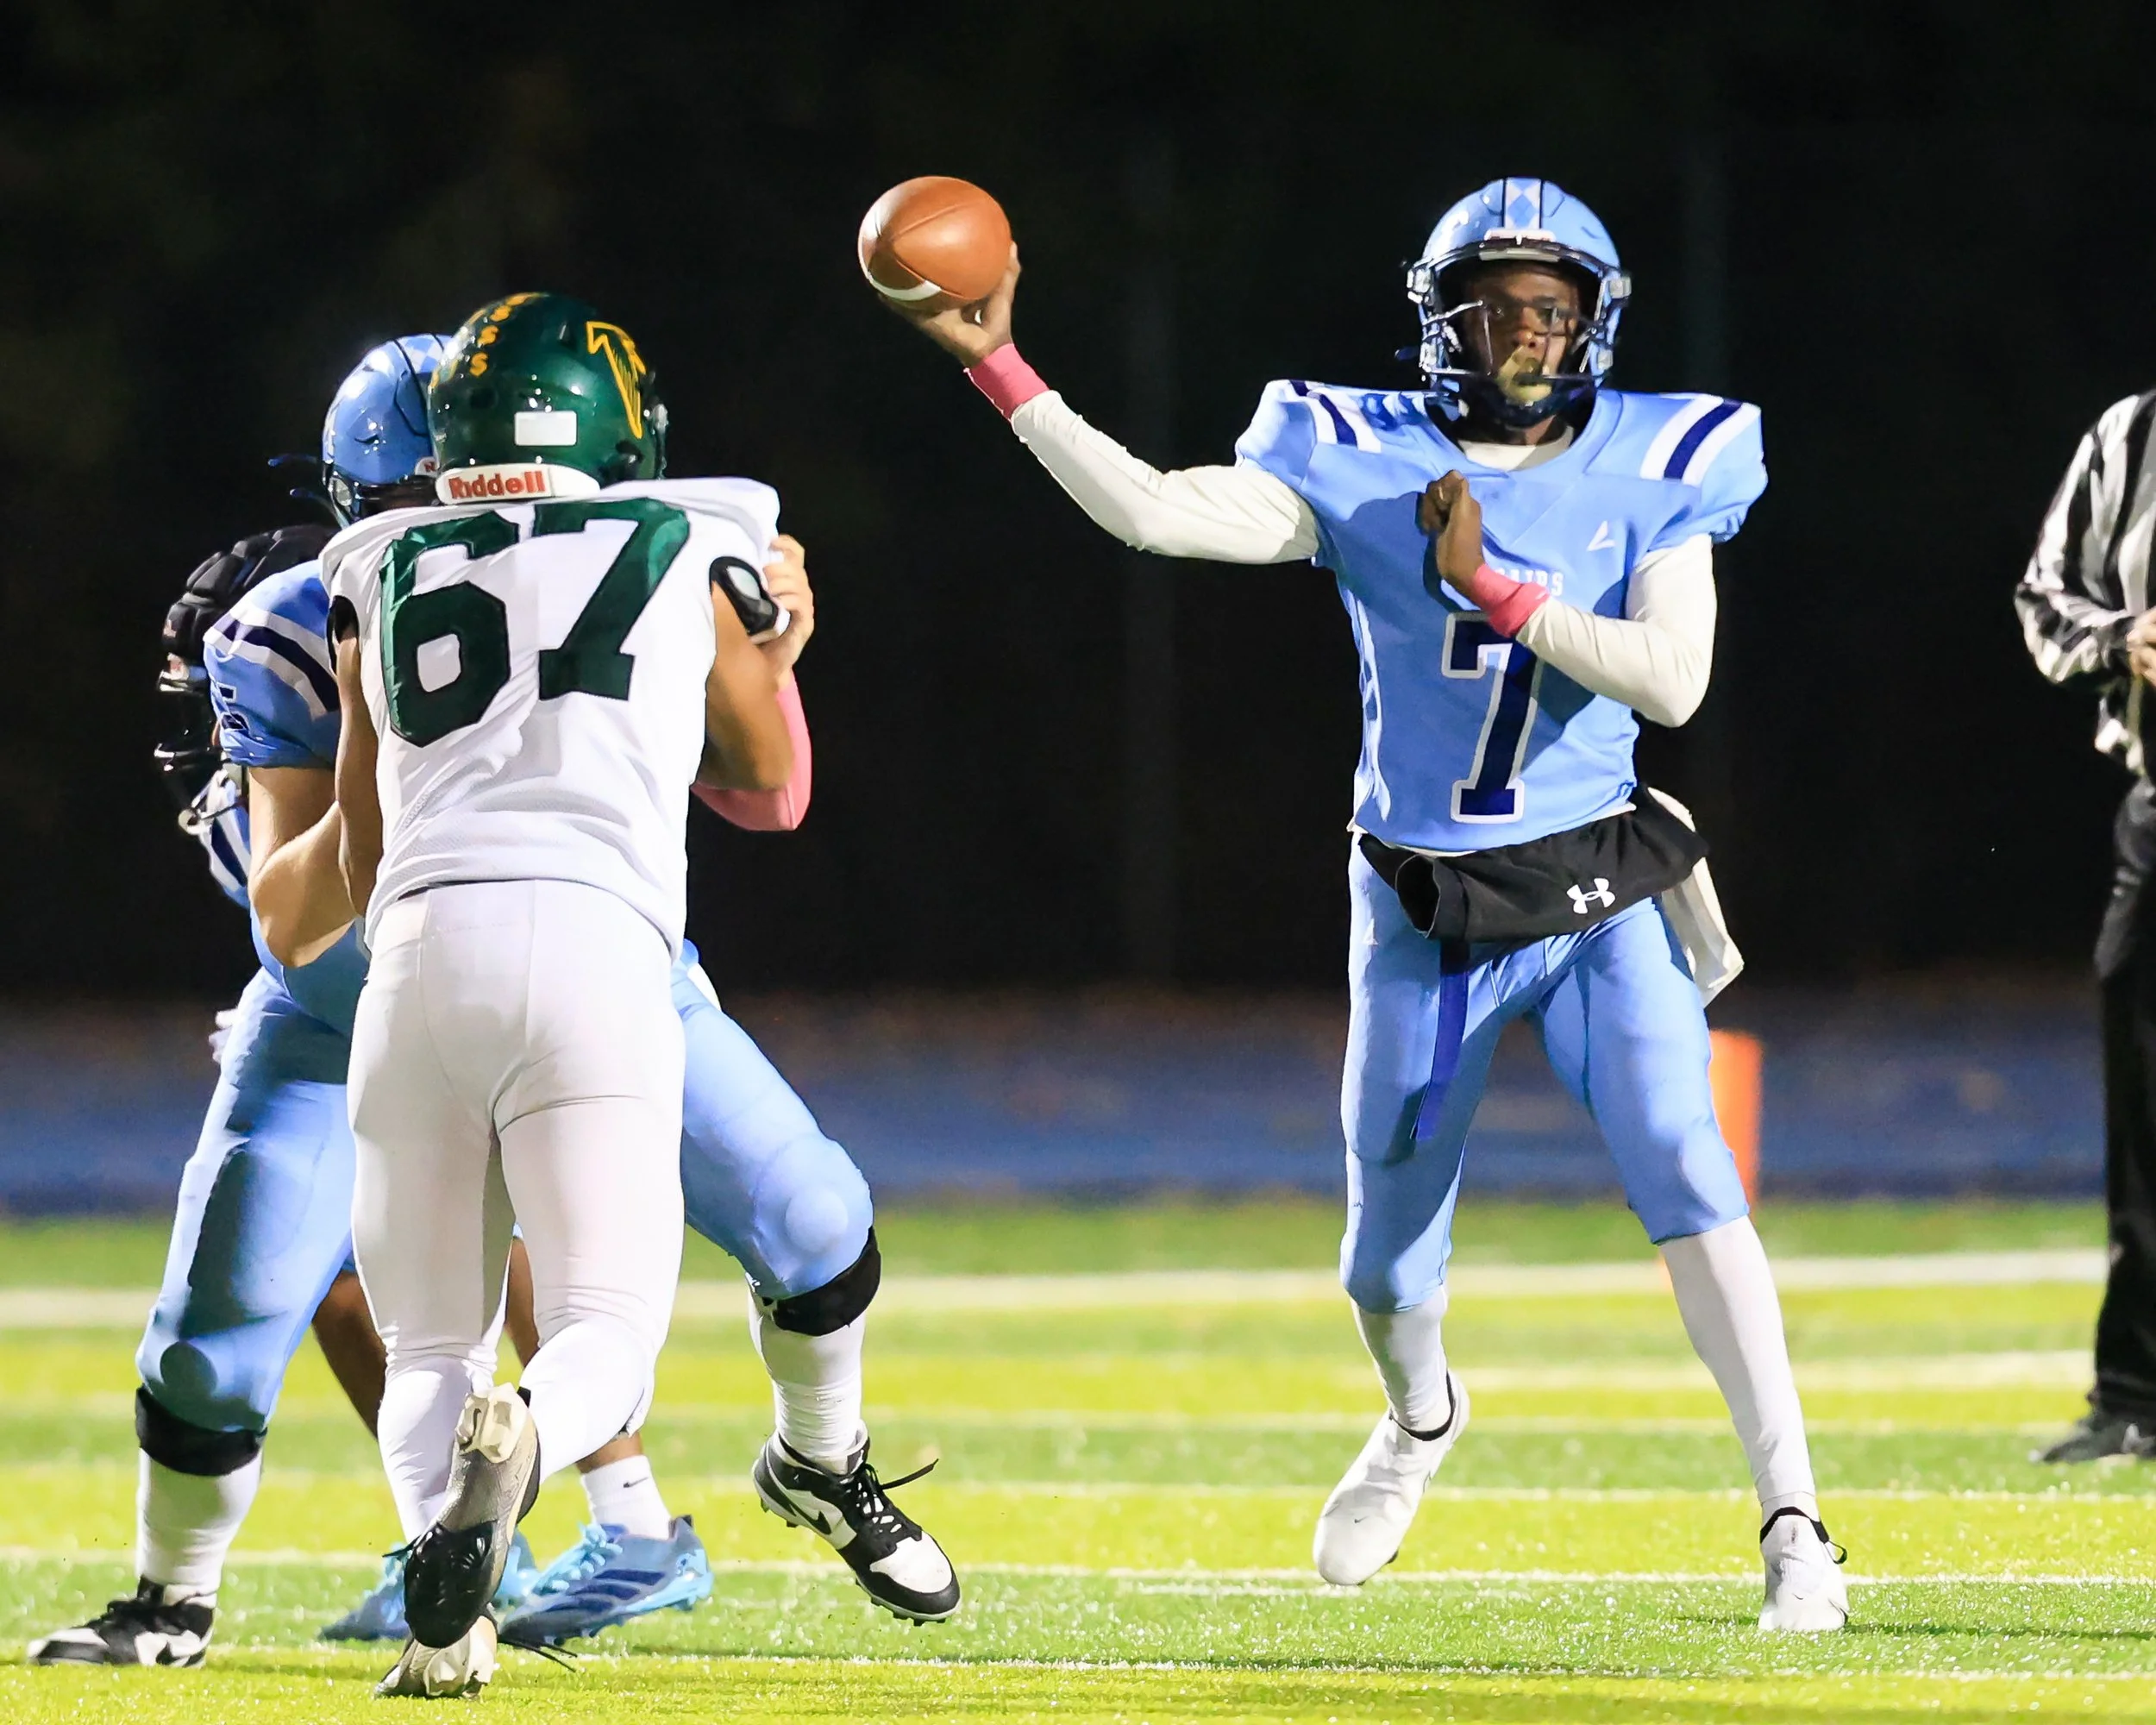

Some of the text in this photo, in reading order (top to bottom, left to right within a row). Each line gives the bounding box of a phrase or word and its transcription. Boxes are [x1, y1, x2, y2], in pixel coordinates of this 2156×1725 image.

[448, 471, 546, 499] Riddell
[379, 498, 690, 747] 67
[1441, 610, 1542, 824] 7
